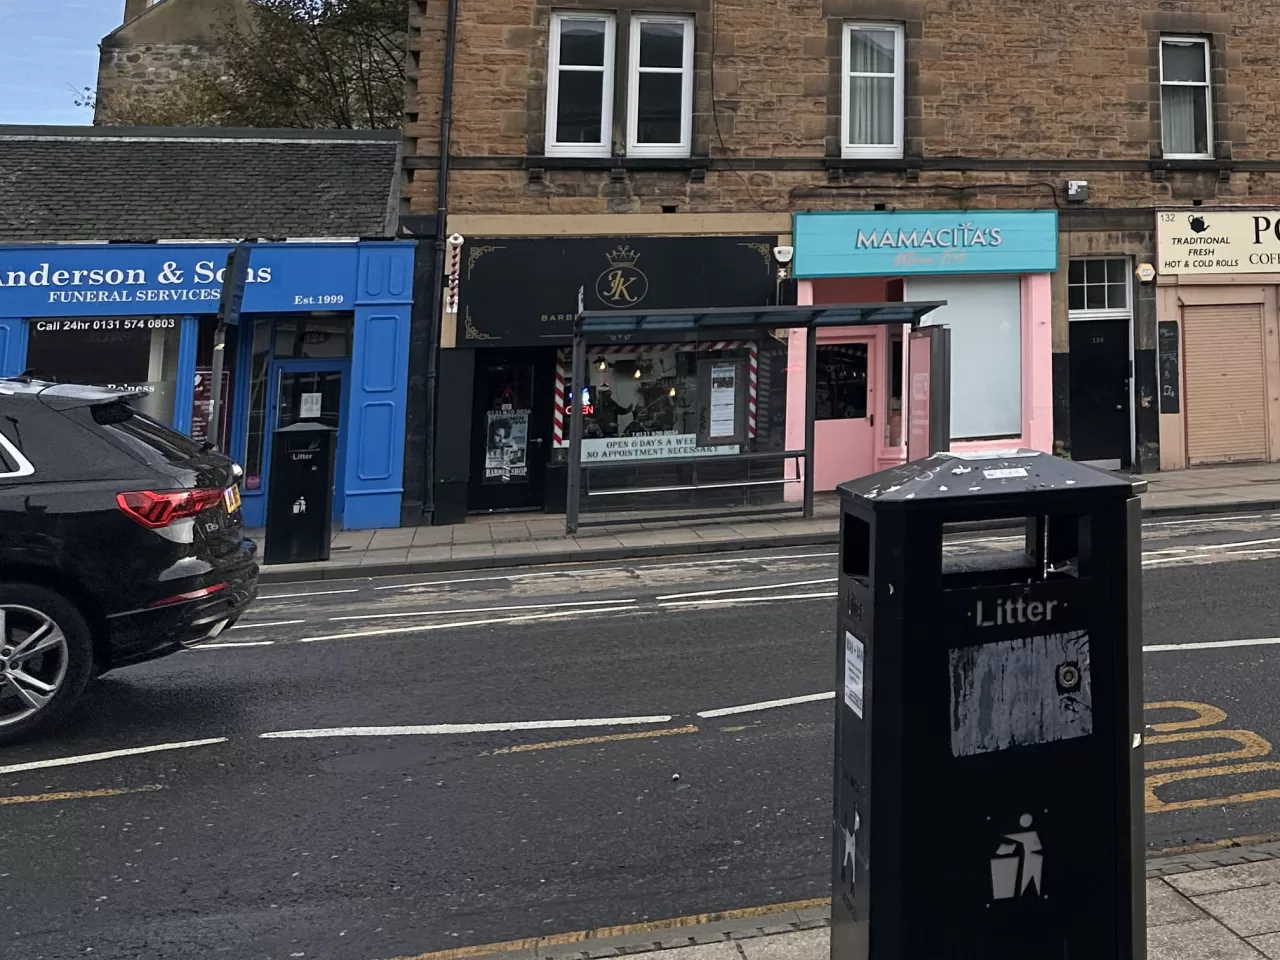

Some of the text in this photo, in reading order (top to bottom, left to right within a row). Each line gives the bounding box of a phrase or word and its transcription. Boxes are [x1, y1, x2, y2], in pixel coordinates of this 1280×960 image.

[1160, 213, 1176, 222] 132
[855, 221, 1002, 249] MAMACITA'S
[1171, 236, 1231, 245] TRADITIONAL
[1188, 248, 1215, 256] FRESH
[1164, 259, 1239, 268] HOT & COLD ROLLS
[0, 263, 147, 287] nderson
[157, 261, 184, 284] &
[48, 288, 221, 303] FUNERAL SERVICES
[317, 294, 344, 304] 1999
[37, 319, 175, 331] Call 24hr 0131 574 0803
[565, 405, 594, 415] OEN
[606, 437, 696, 449] OPEN 6 DAYS A WEE
[587, 451, 599, 459] NO
[601, 447, 664, 458] APPOINTMENT
[976, 598, 1058, 627] Litter
